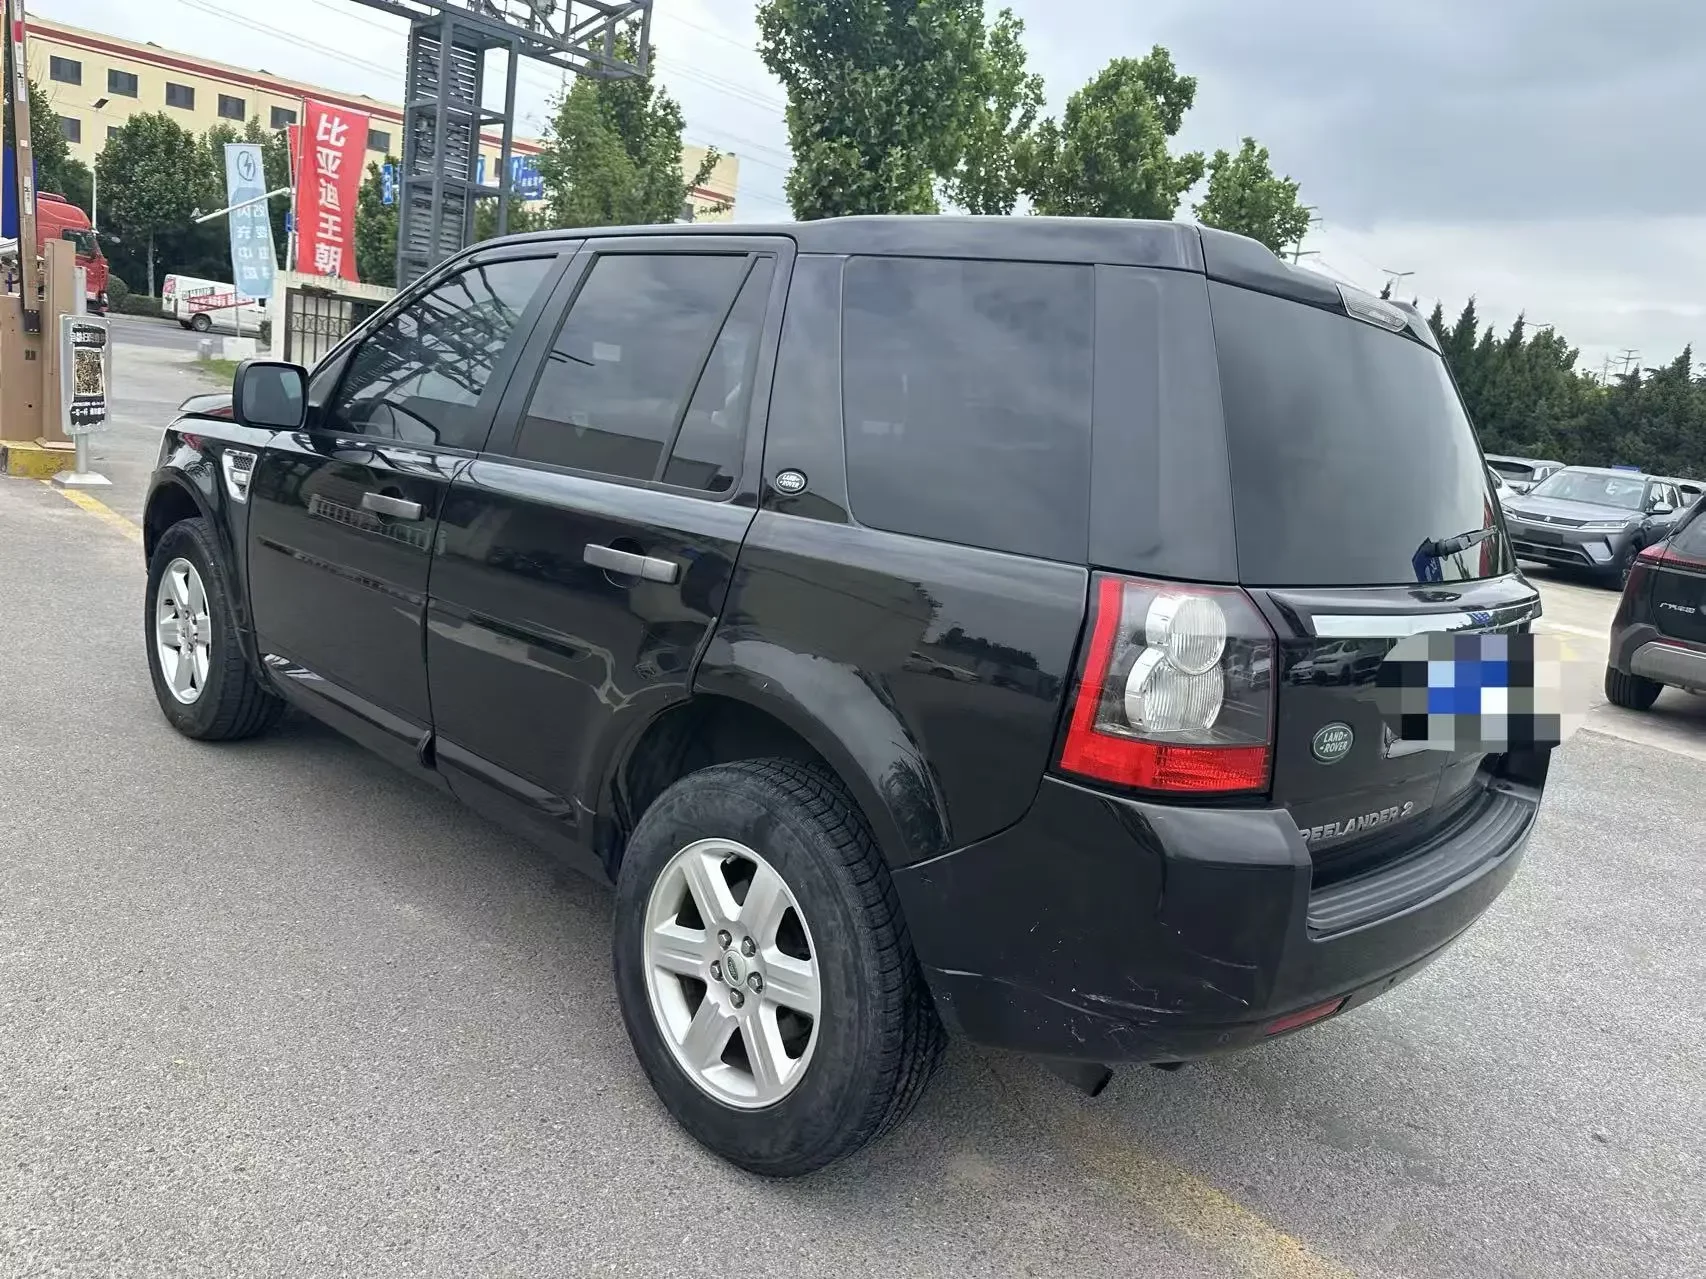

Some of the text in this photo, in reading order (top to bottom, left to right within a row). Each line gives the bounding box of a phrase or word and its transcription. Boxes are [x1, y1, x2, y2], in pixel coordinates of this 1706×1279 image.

[314, 112, 349, 279] 比亚迪王朝
[1323, 731, 1344, 743] LAND
[1323, 741, 1348, 753] ROVER
[1299, 801, 1414, 841] REELANDER 2
